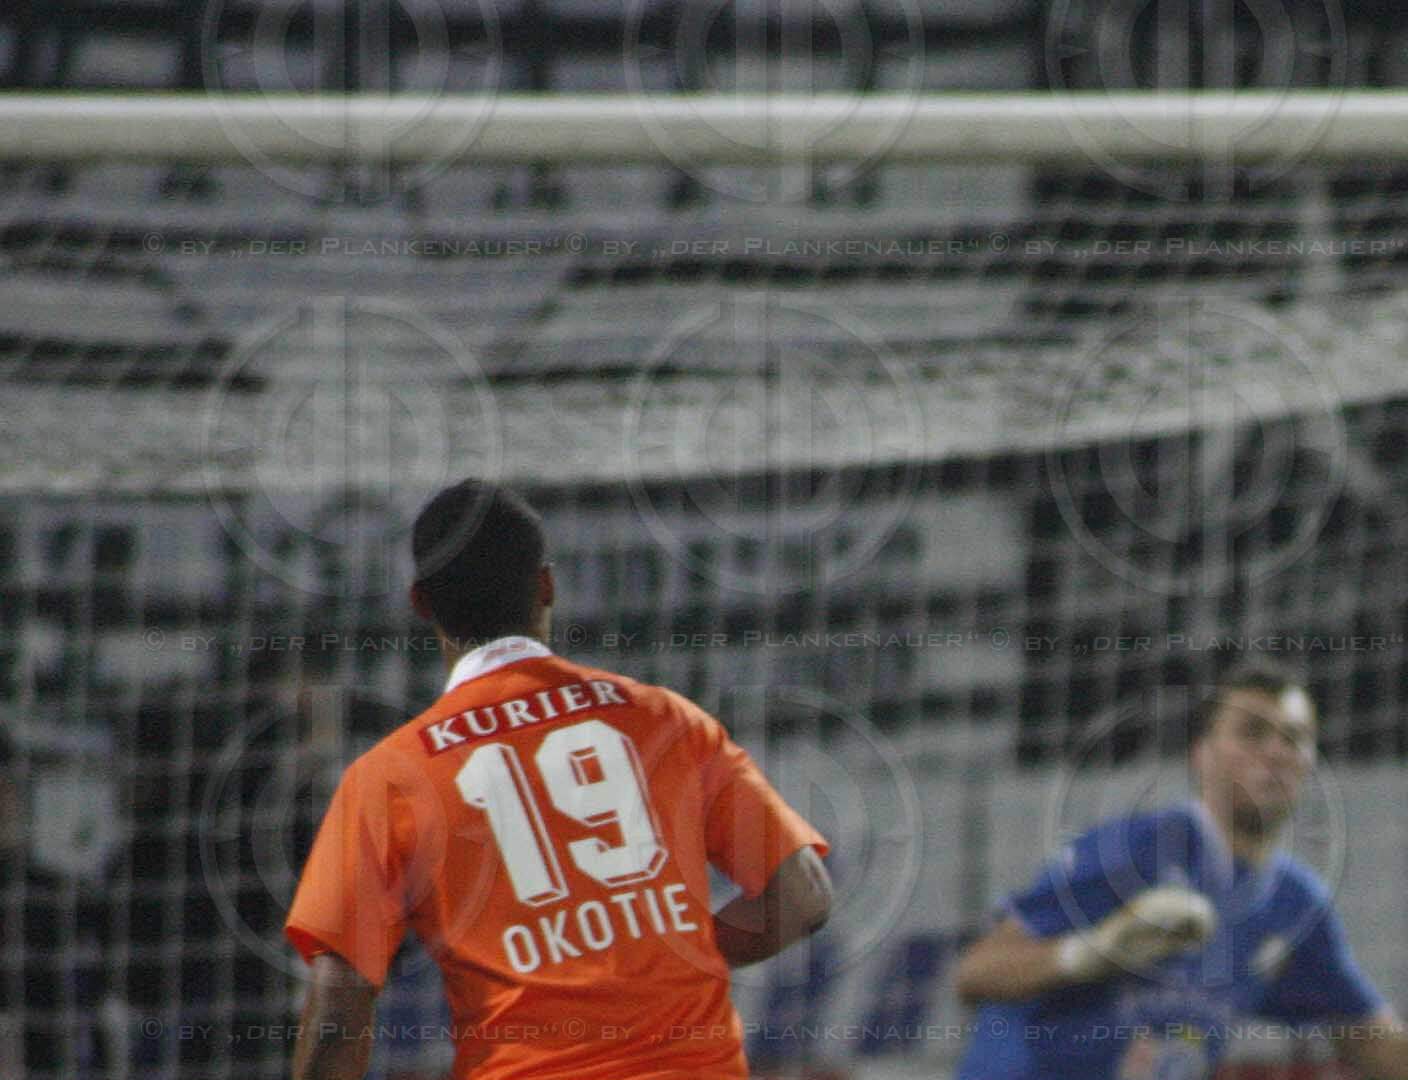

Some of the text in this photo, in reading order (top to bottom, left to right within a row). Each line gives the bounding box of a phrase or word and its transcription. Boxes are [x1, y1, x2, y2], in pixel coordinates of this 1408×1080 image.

[427, 680, 627, 750] KURIER
[455, 719, 669, 907] 19
[504, 883, 698, 974] OKOTIE
